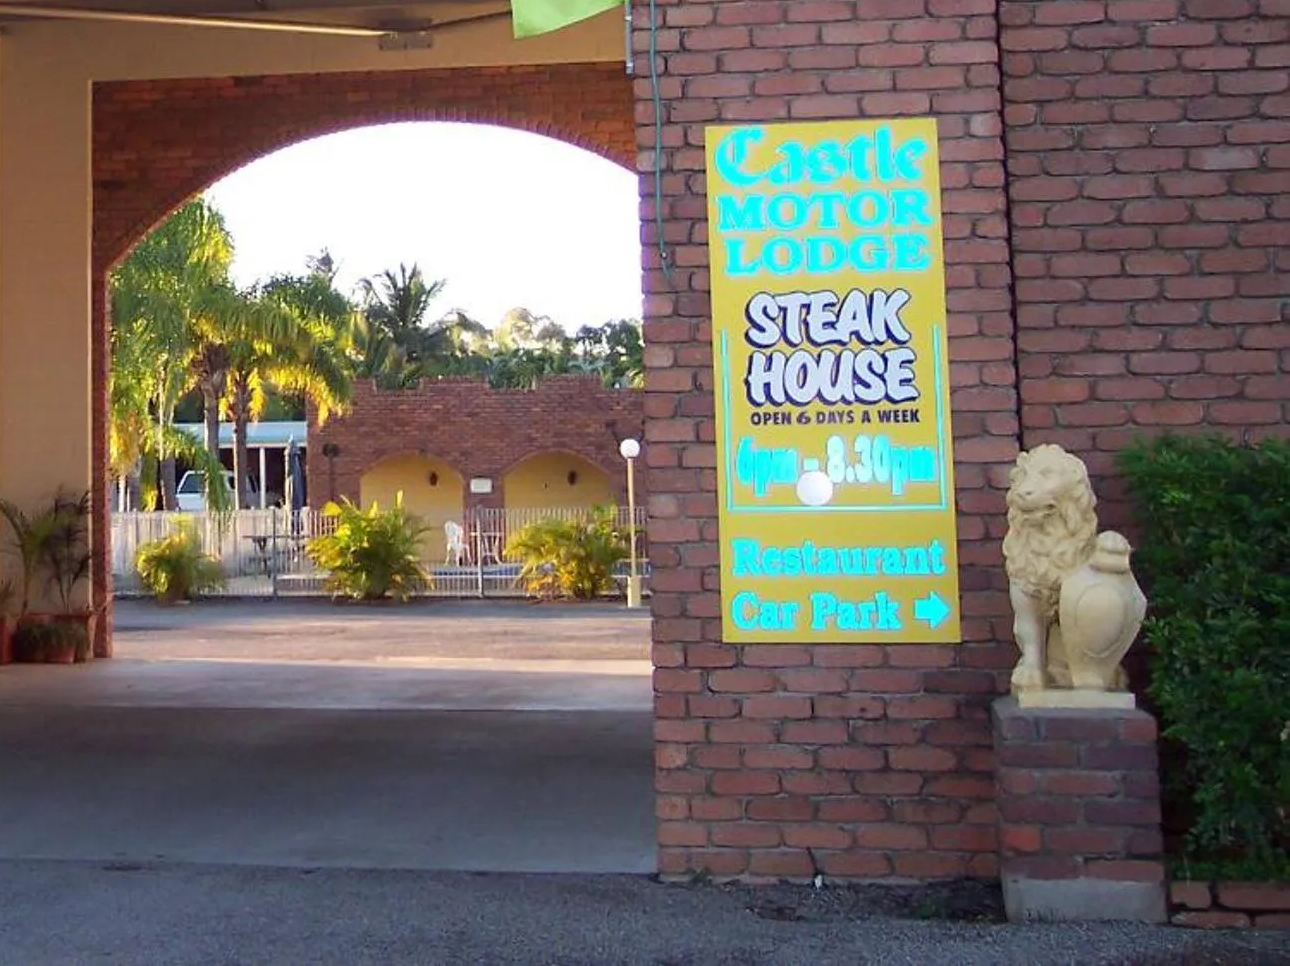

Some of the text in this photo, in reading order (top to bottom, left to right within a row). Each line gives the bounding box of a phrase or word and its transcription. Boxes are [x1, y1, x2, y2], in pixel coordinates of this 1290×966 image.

[715, 125, 928, 186] Castle
[716, 189, 932, 231] MOTOR
[724, 233, 932, 275] LODGE
[745, 288, 912, 348] STEAK
[744, 347, 920, 407] HOUSE
[750, 409, 920, 426] OPEN 6 DAYS A WEEK
[736, 436, 798, 497] 6pm
[825, 434, 936, 496] 8.30pm
[731, 538, 947, 576] Restaurant
[731, 591, 903, 630] Car Park
